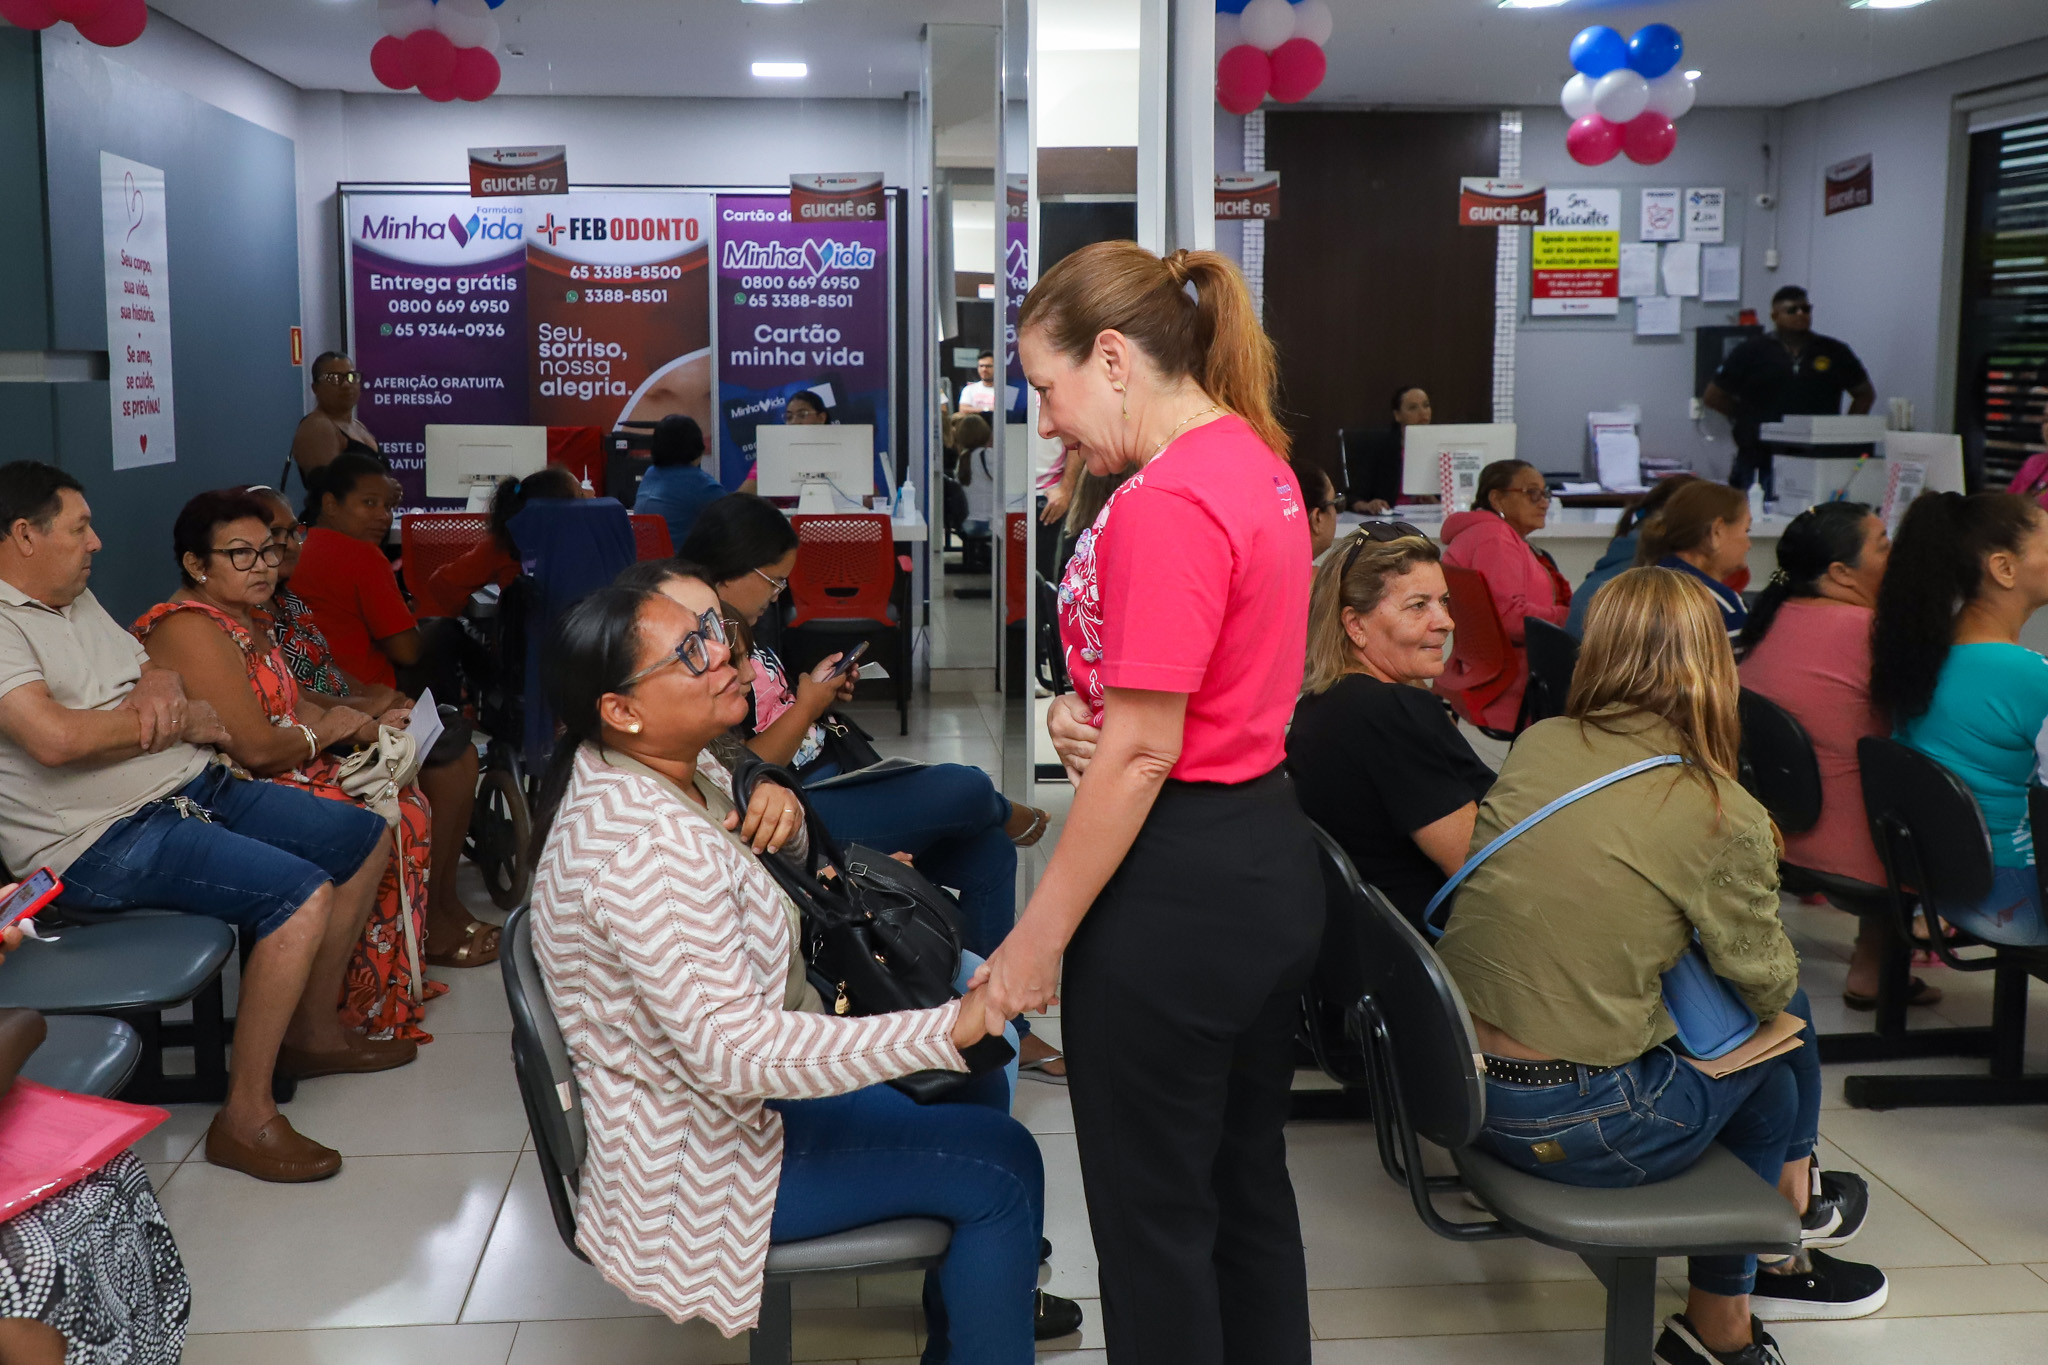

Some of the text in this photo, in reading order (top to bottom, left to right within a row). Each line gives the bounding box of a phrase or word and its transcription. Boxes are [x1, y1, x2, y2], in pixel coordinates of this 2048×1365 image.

[481, 174, 558, 192] GUICHÊ 07
[477, 206, 523, 214] Farmácia
[723, 209, 775, 222] Cartão
[801, 200, 876, 218] GUICHÊ 06
[1253, 203, 1270, 216] 05
[1469, 205, 1538, 223] GUICHÊ 04
[1547, 207, 1609, 226] Pacientes
[610, 217, 699, 241] ODONTO
[121, 249, 152, 277] Seu corpo,
[570, 266, 681, 279] 65 3388-8500
[124, 279, 149, 299] sua vida,
[370, 273, 517, 294] Entrega grátis
[742, 276, 860, 289] 0800 669 6950
[585, 289, 668, 302] 3388-8501
[749, 294, 853, 307] 65 3388-8501
[121, 304, 155, 322] sua história.
[388, 300, 509, 313] 0800 669 6950
[395, 323, 505, 337] 65 9344-0936
[539, 323, 582, 342] Seu
[754, 324, 840, 344] Cartão
[127, 345, 152, 366] Se ame,
[539, 338, 628, 360] sorriso,
[731, 346, 864, 366] minha vida
[540, 360, 610, 375] nossa
[126, 371, 154, 392] se cuide,
[374, 375, 504, 391] AFERIÇÃO GRATUITA
[539, 377, 632, 400] alegria.
[374, 392, 452, 404] DE PRESSÃO
